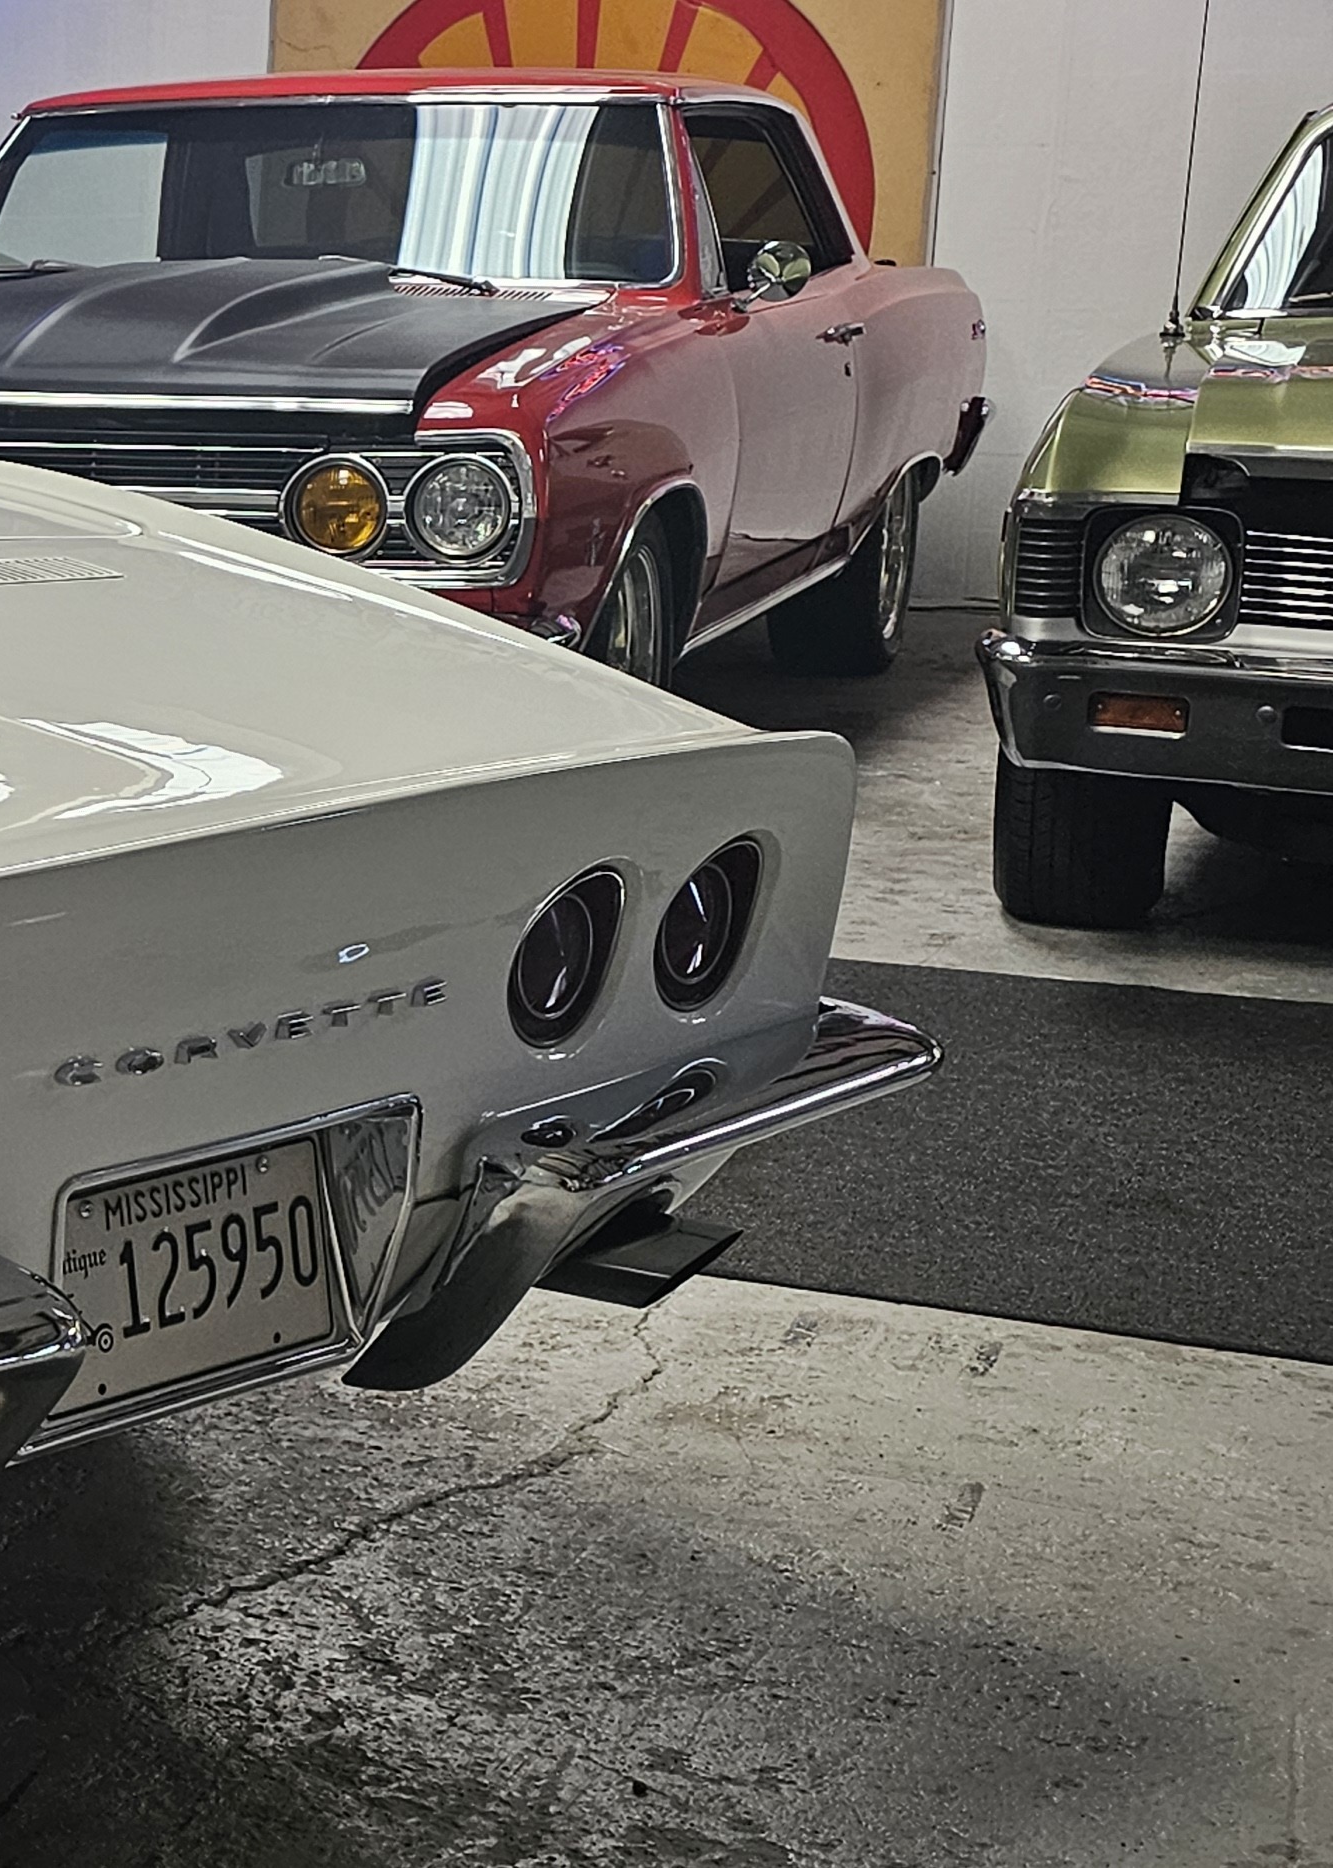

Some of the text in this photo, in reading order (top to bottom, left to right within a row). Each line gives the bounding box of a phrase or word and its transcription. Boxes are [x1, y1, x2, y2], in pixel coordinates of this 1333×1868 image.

[54, 976, 448, 1086] CORVETTE
[104, 1163, 248, 1231] MISSISSIPPI
[119, 1195, 319, 1339] 125950
